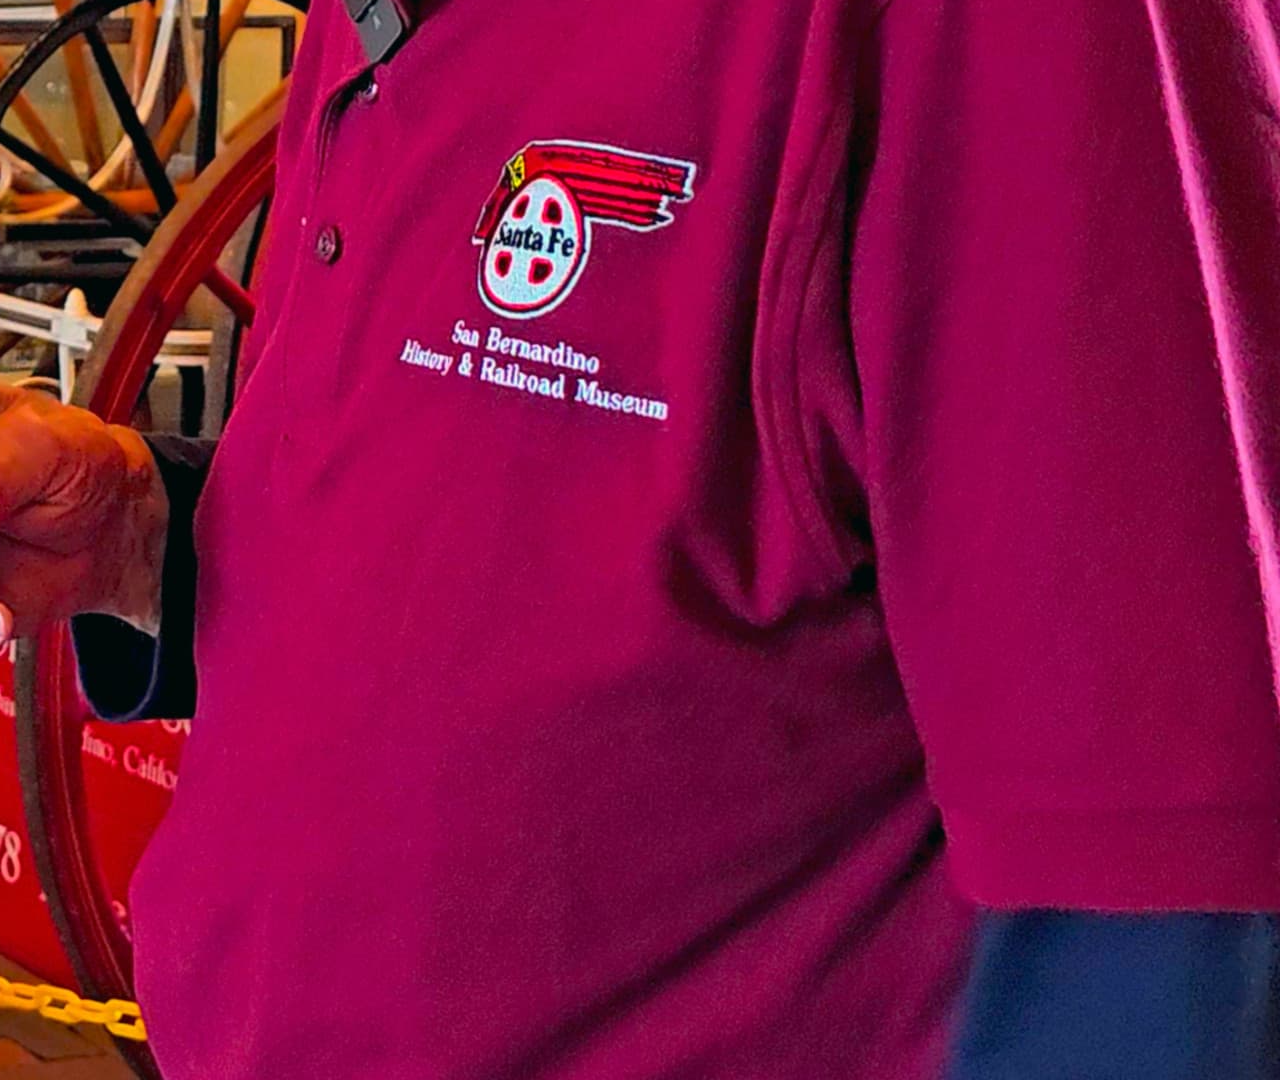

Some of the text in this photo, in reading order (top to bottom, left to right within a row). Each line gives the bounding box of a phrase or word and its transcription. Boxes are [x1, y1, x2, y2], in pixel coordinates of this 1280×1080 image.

[495, 222, 576, 257] Santa Fe
[452, 319, 600, 375] San Bernardino
[400, 338, 669, 421] History & Railroad Museum
